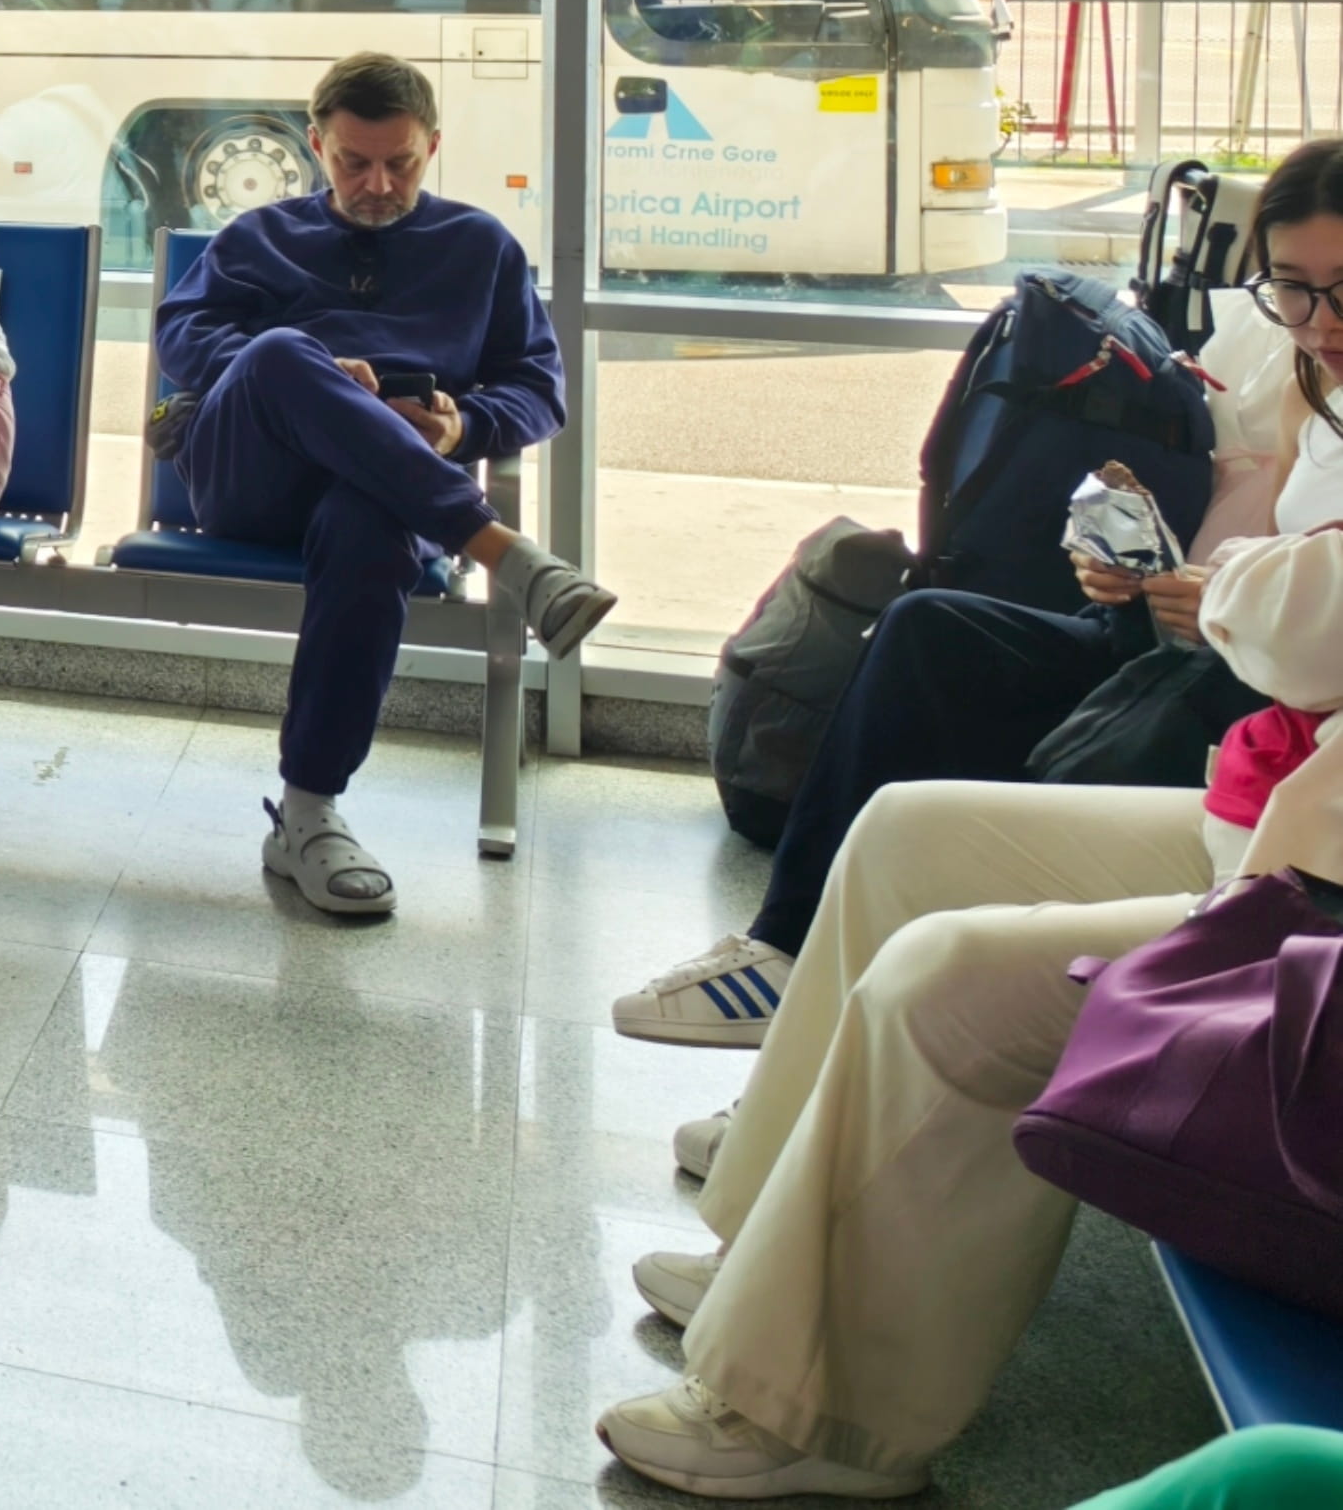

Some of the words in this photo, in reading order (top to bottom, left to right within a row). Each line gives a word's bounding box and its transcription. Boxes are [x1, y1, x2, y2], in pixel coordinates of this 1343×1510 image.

[661, 144, 714, 162] Crne
[722, 145, 777, 163] Gore
[691, 190, 801, 222] Airport
[650, 225, 768, 254] Handling
